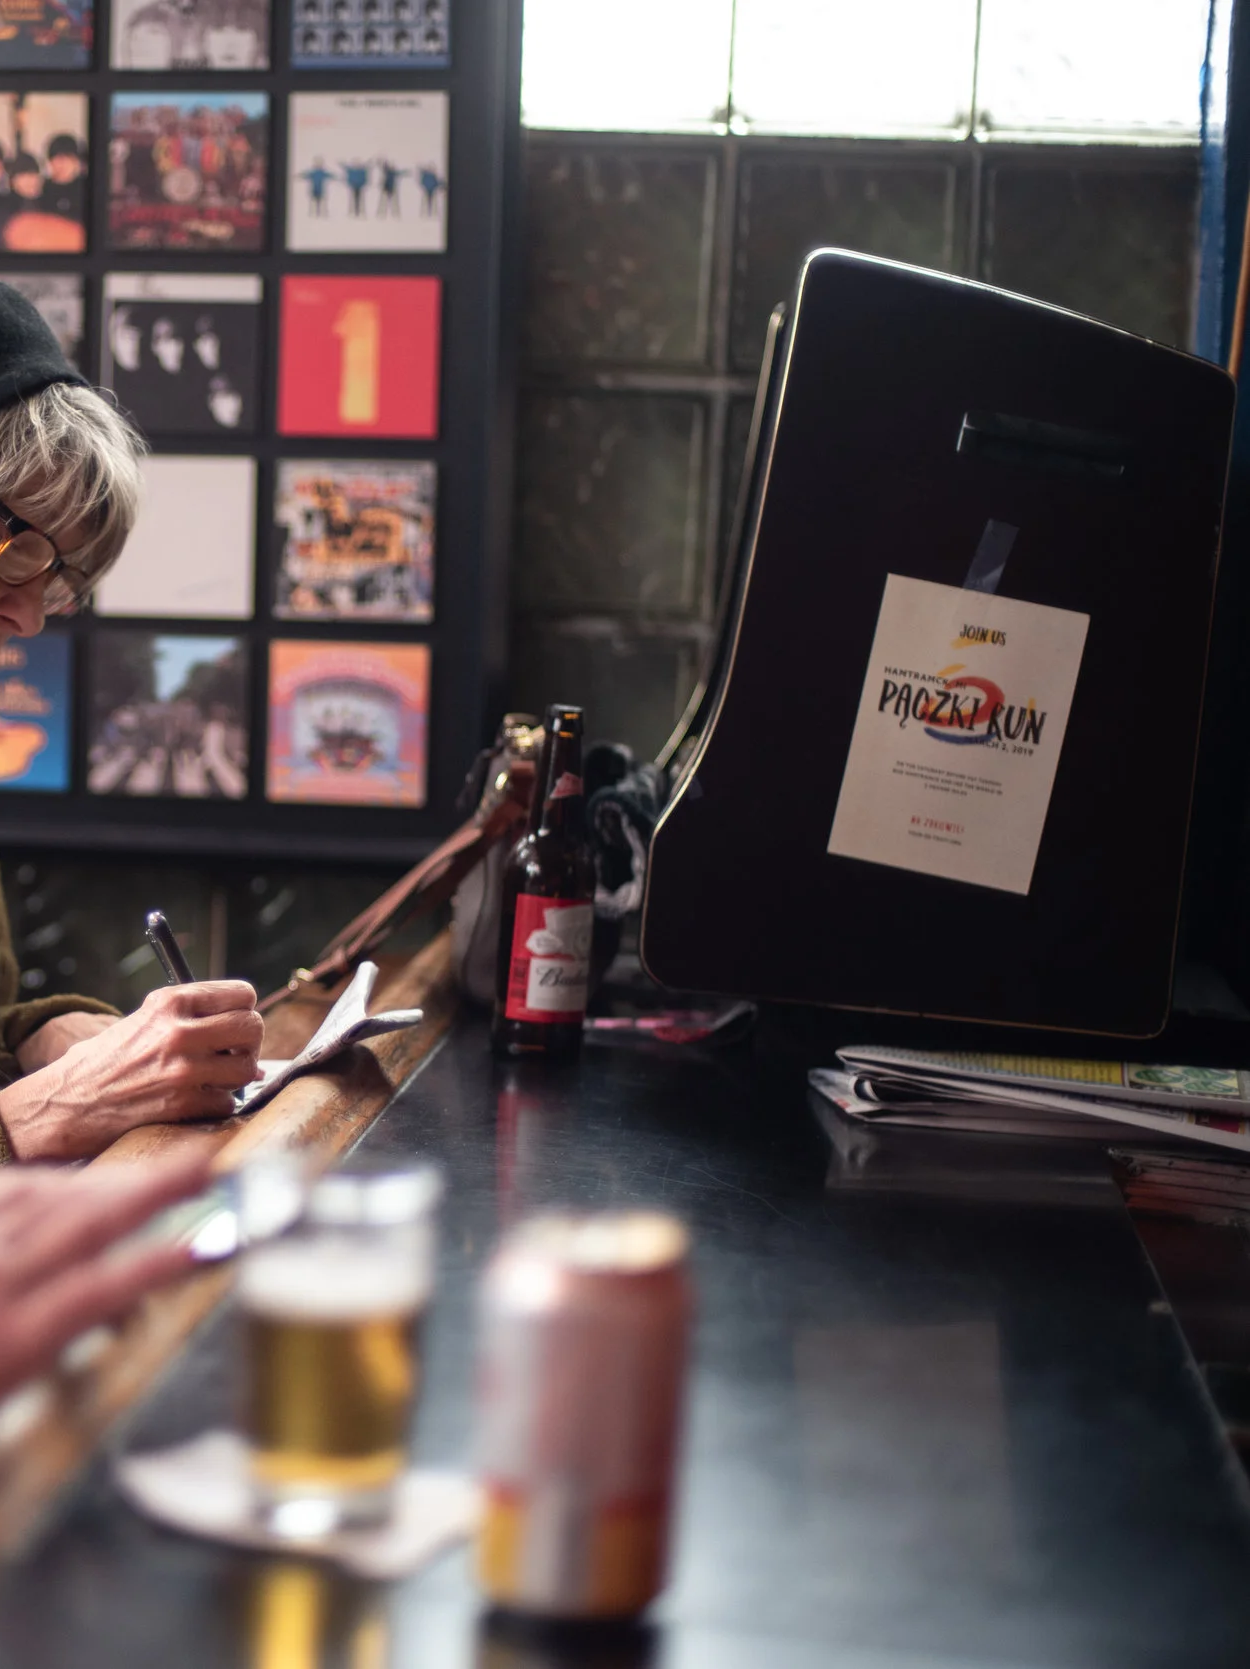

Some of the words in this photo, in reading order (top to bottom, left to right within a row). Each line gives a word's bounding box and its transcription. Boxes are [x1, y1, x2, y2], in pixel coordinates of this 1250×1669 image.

[332, 298, 380, 425] 1
[959, 624, 988, 643] JOIN
[991, 627, 1007, 646] US
[987, 704, 1048, 745] RUN
